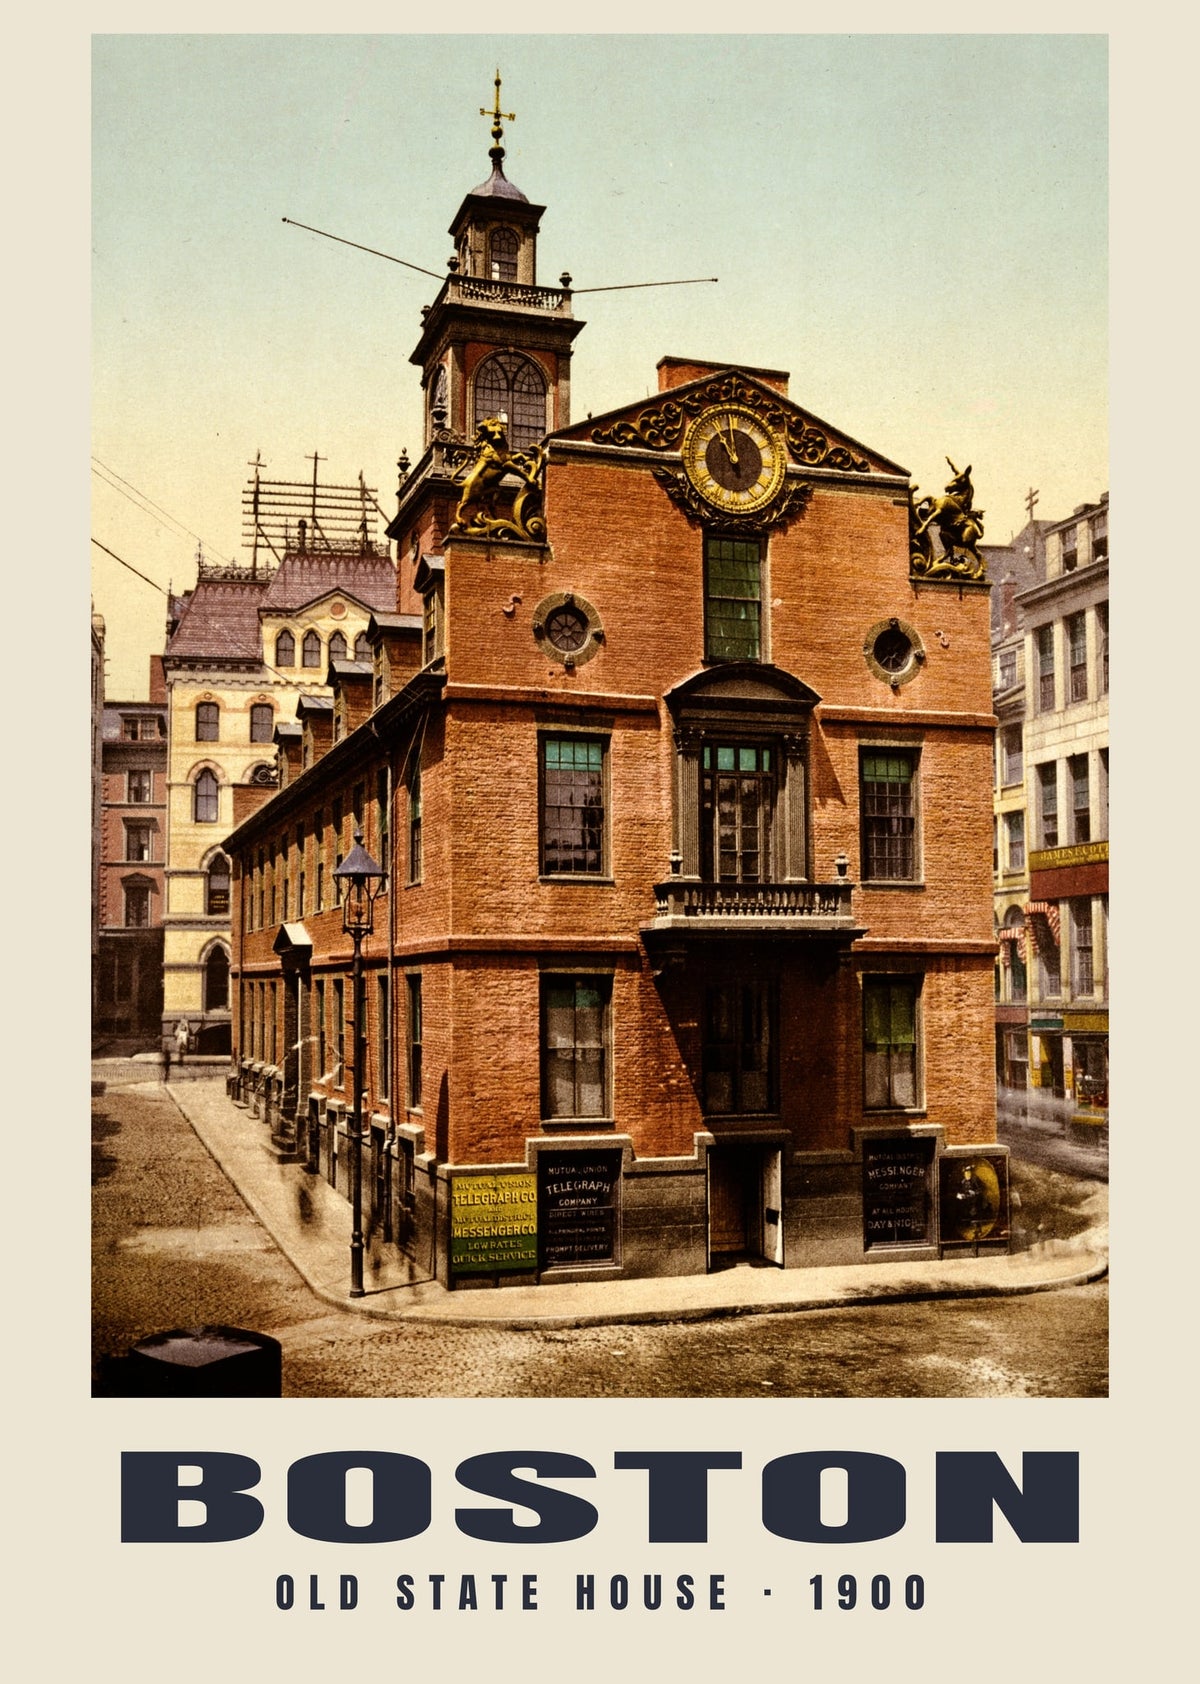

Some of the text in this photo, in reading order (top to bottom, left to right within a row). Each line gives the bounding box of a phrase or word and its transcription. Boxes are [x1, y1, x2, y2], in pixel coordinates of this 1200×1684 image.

[583, 1165, 608, 1174] UNION
[868, 1166, 925, 1180] MESSENGER
[456, 1180, 532, 1191] MUTUAL UNION
[545, 1180, 611, 1195] TELEGRAPH
[453, 1191, 519, 1206] TELEGRAPH
[558, 1197, 597, 1207] COMPANY
[896, 1206, 920, 1214] HOUR
[455, 1215, 491, 1224] MUTUAL
[453, 1225, 521, 1238] MESSENGER
[467, 1240, 523, 1250] LOW RATES
[453, 1250, 536, 1264] QUICK SERVICE
